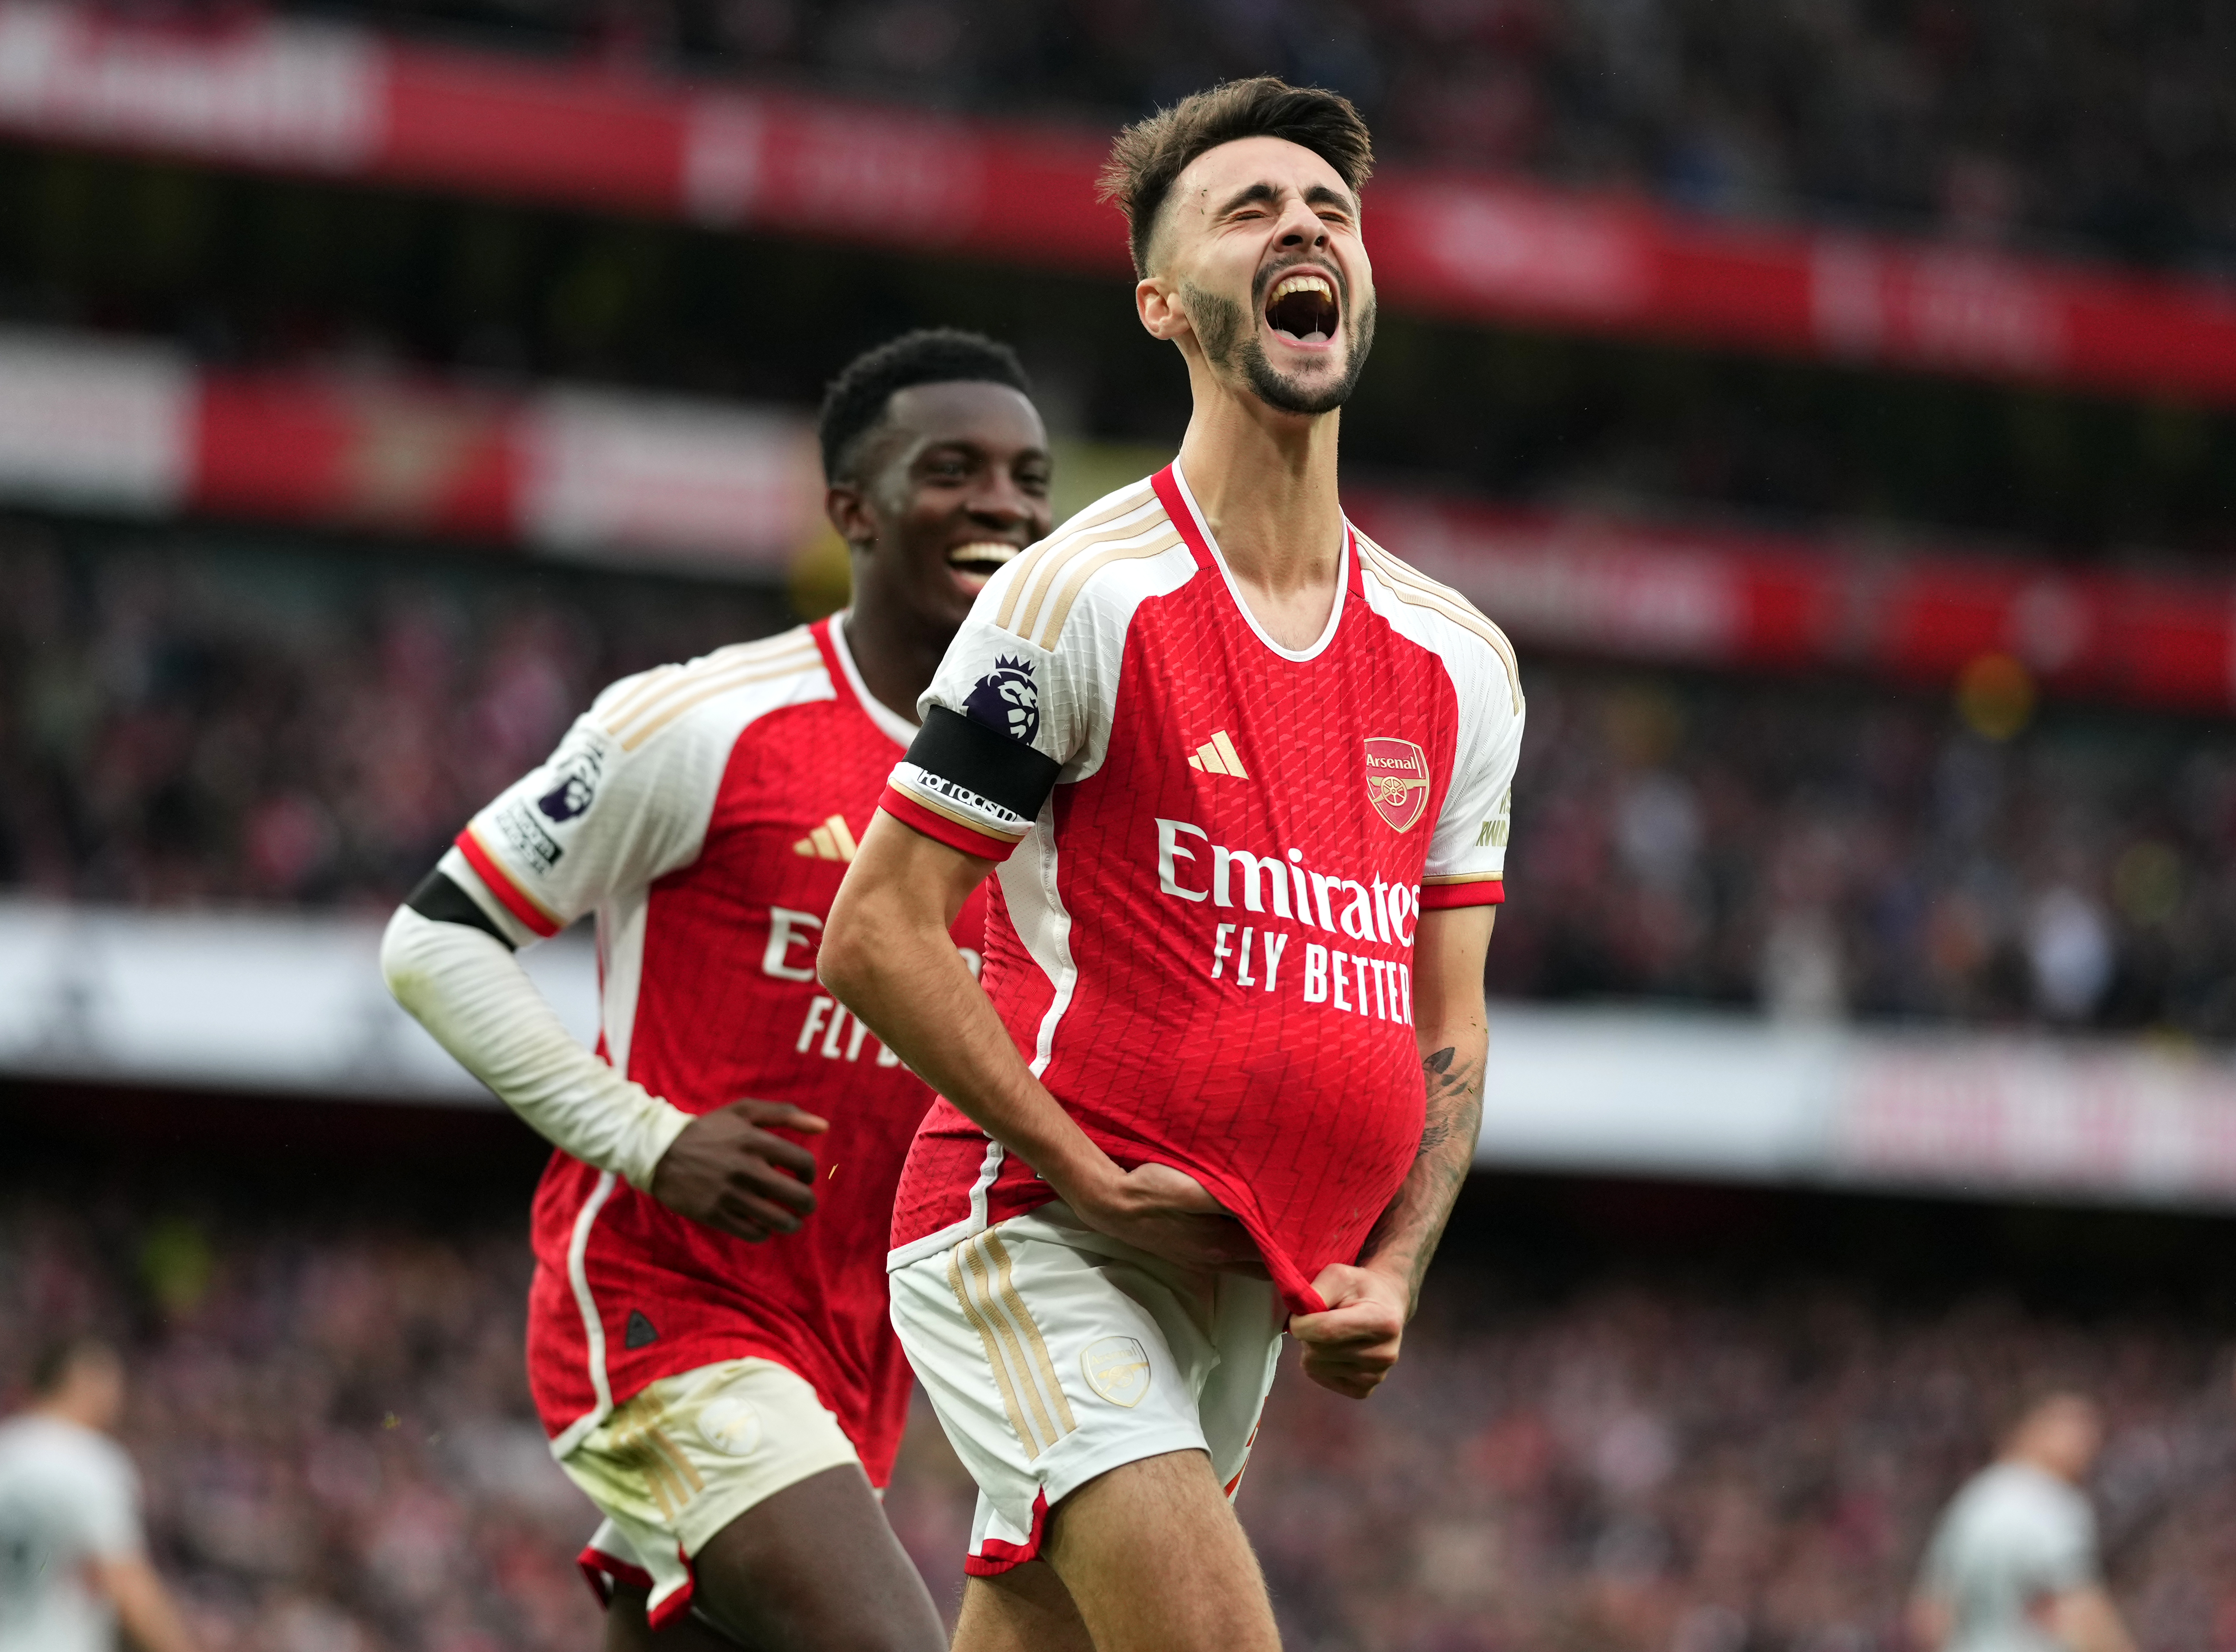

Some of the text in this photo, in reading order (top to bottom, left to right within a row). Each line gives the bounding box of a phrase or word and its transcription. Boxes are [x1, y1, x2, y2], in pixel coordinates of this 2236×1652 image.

[1366, 753, 1417, 769] Arsenal
[949, 784, 1017, 822] racism
[1211, 923, 1413, 1027] FLY BETTER
[1091, 1346, 1137, 1366] Arsenal
